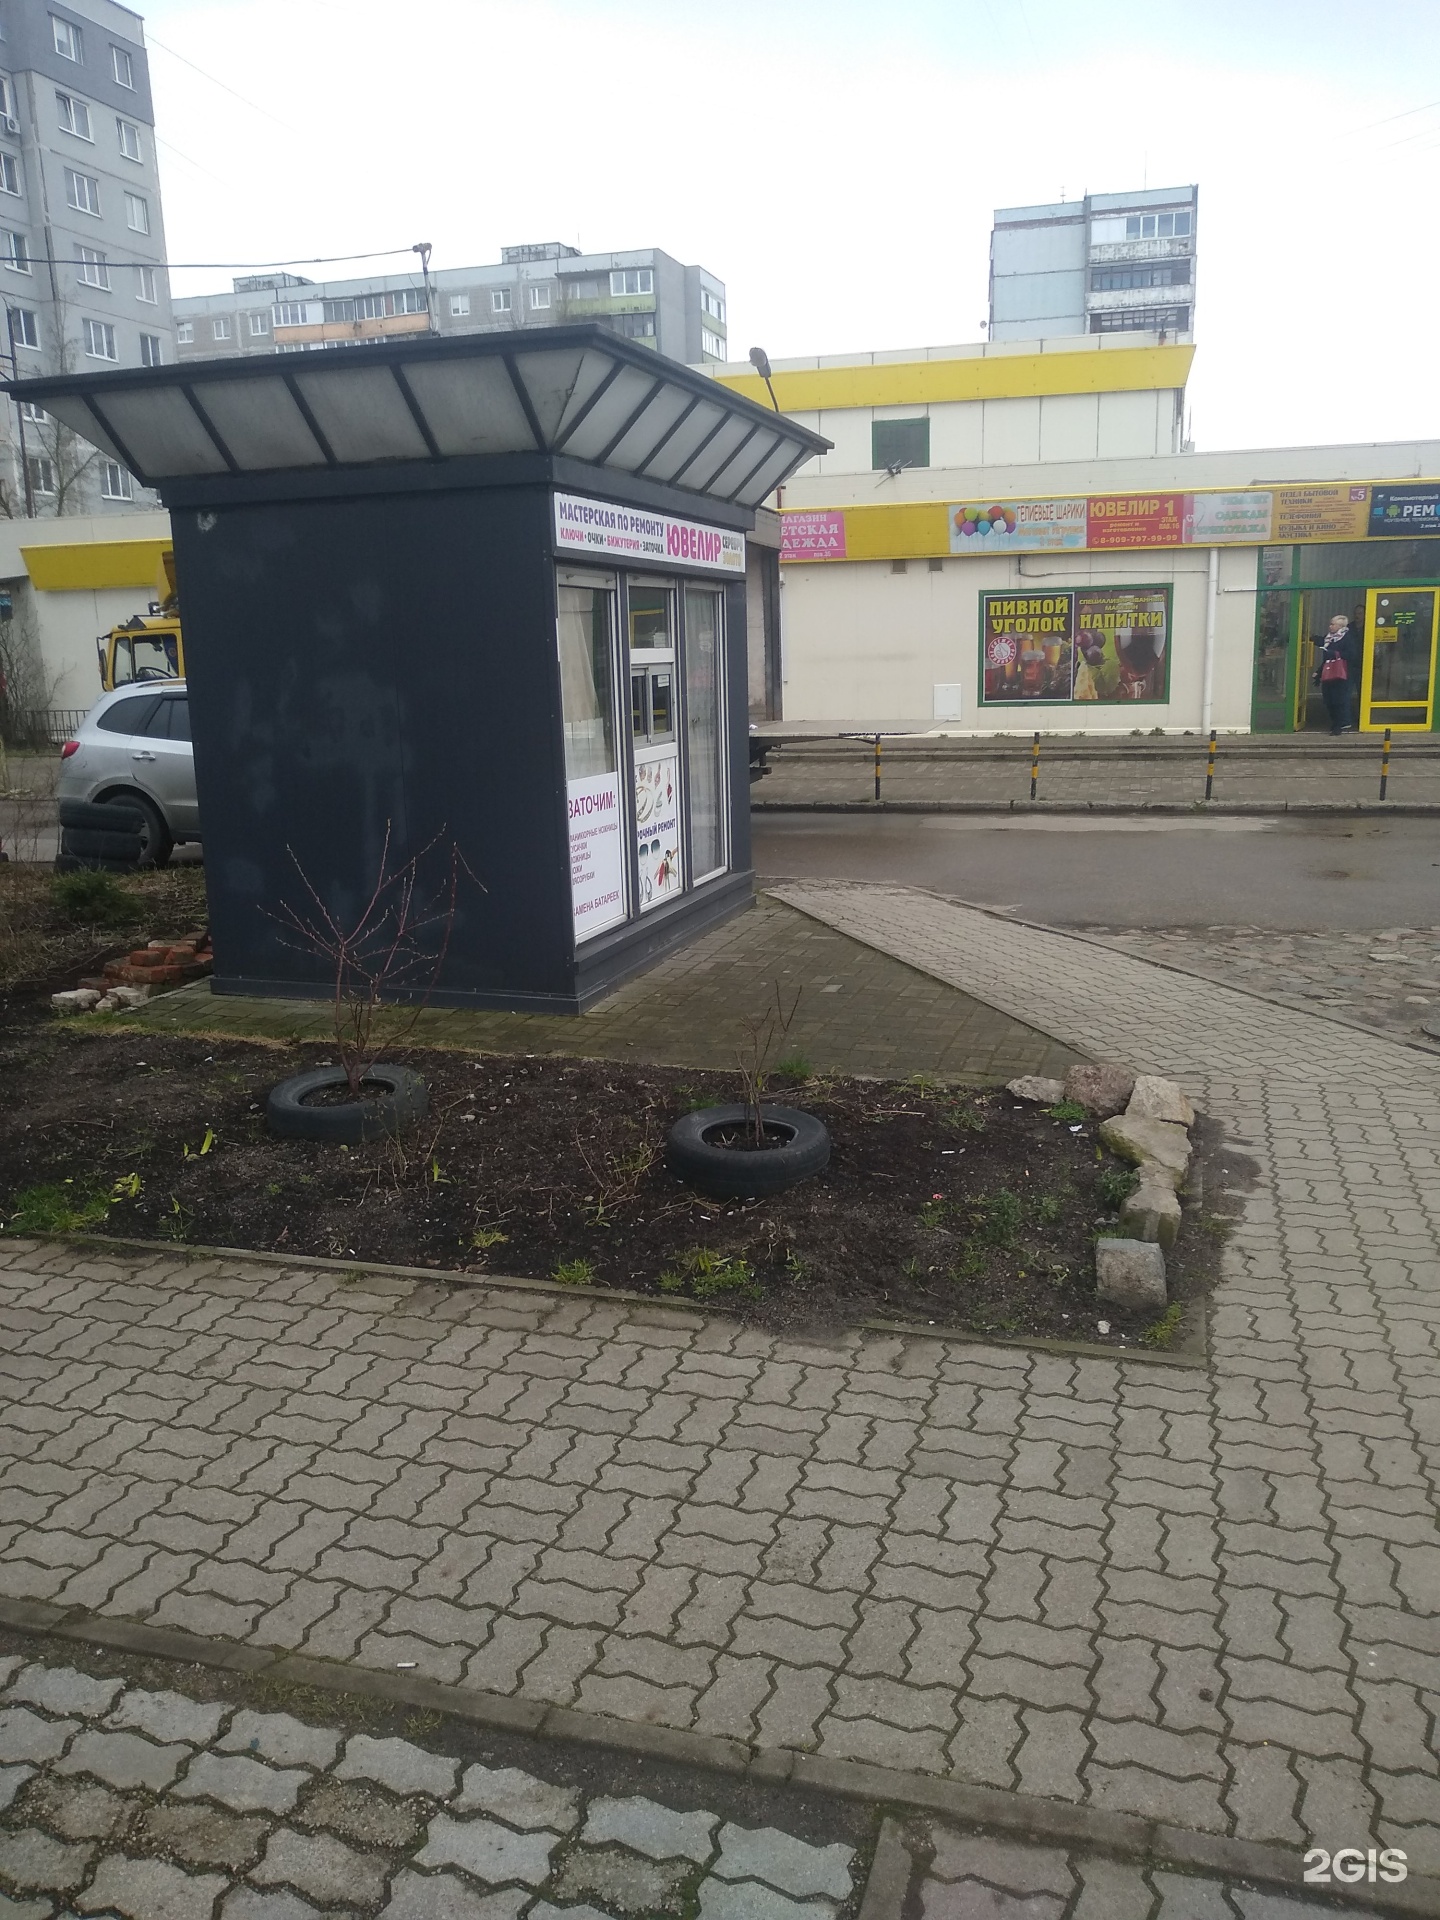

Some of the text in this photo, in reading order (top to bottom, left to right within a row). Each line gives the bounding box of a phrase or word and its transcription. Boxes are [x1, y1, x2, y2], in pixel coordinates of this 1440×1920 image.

[1017, 504, 1086, 522] ГЕЛИЕВЫЕ ШАРИКИ
[1090, 499, 1174, 518] ЮВЕЛИР 1
[559, 502, 664, 537] МАСТЕРСКАЯ ПО РЕМОНТУ
[781, 524, 838, 536] ЕТСКАЯ
[560, 527, 664, 554] КЛЮЧИ ОЧКИ БИЖУТЕРИЯ ЗАТОЧКА
[666, 524, 722, 562] ЮВЕЛИР
[782, 537, 838, 549] ДЕЖДА
[989, 597, 1069, 616] ПИВНОЙ
[992, 617, 1066, 634] УГОЛОК
[1080, 612, 1163, 629] НАПИТКИ
[569, 791, 616, 818] ЗАТОЧИМ:
[658, 818, 676, 834] РЕМОНТ
[572, 864, 582, 874] ОЖИ
[595, 890, 619, 908] БАТАРЕЕК
